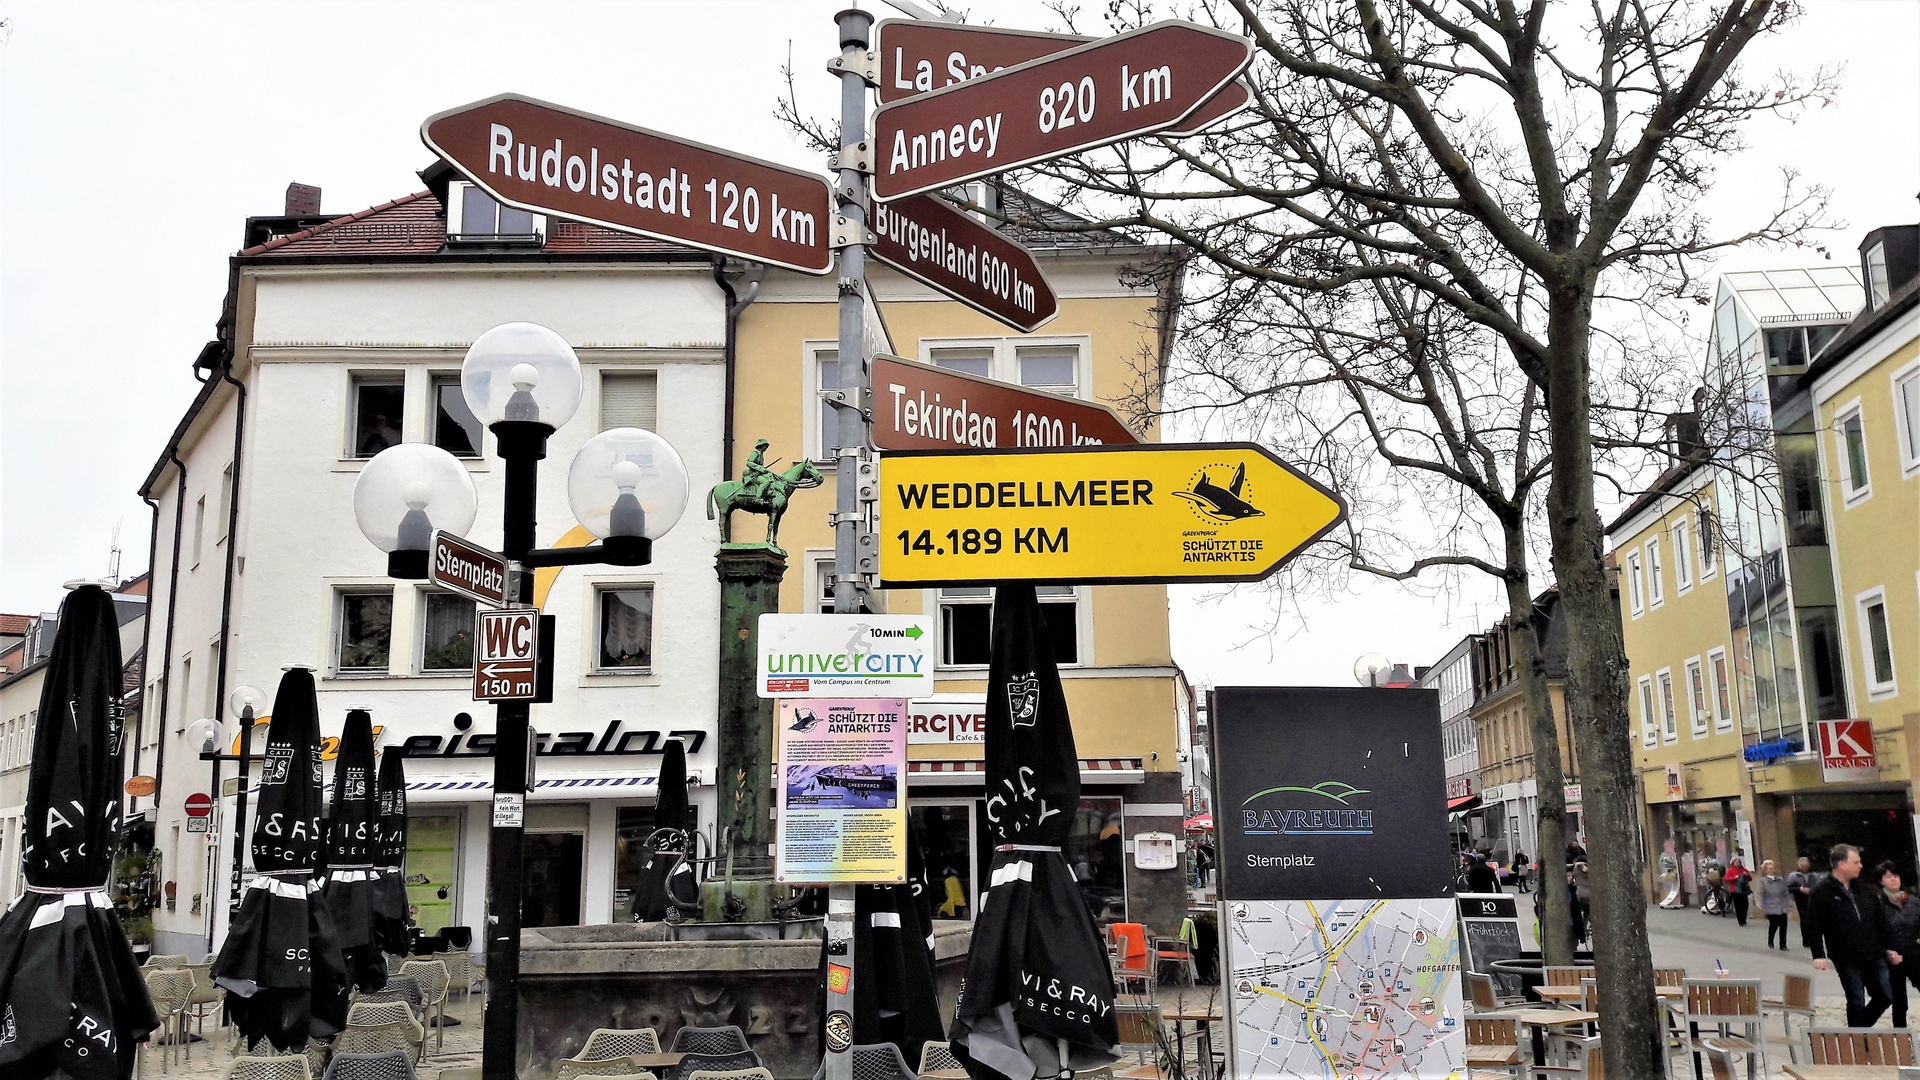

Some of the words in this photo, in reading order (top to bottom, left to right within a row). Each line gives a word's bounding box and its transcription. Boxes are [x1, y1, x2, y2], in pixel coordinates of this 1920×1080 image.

[894, 46, 934, 92] La
[889, 113, 1002, 175] Annecy
[1039, 76, 1096, 134] 820
[1121, 64, 1171, 111] km
[488, 122, 691, 218] Rudolstadt
[704, 178, 760, 233] 120
[771, 193, 815, 247] km
[875, 202, 977, 283] Burgenland
[981, 250, 1009, 301] 600
[1014, 269, 1035, 314] km
[1012, 409, 1064, 447] 1600
[1071, 422, 1103, 447] km
[897, 478, 1154, 509] WEDDELLMEER
[897, 528, 1002, 556] 14.189
[1014, 527, 1069, 554] KM
[1183, 538, 1237, 551] SCHÜTZT
[1240, 540, 1263, 550] DIE
[437, 544, 503, 594] Sternplatz
[1183, 552, 1255, 562] ANTARKTIS
[485, 615, 531, 658] WC
[481, 679, 511, 697] 150
[516, 682, 532, 695] m
[828, 679, 853, 687] Campus
[828, 711, 875, 723] SCHÜTZT
[877, 713, 898, 723] DIE
[828, 724, 891, 733] ANTARKTIS
[1823, 721, 1874, 759] K
[1825, 758, 1876, 769] KRAUSE
[1241, 809, 1374, 834] BAYREUTH
[1246, 854, 1316, 869] Sternplatz
[1416, 965, 1461, 973] HOFGARTEN
[1069, 985, 1111, 1018] RAY
